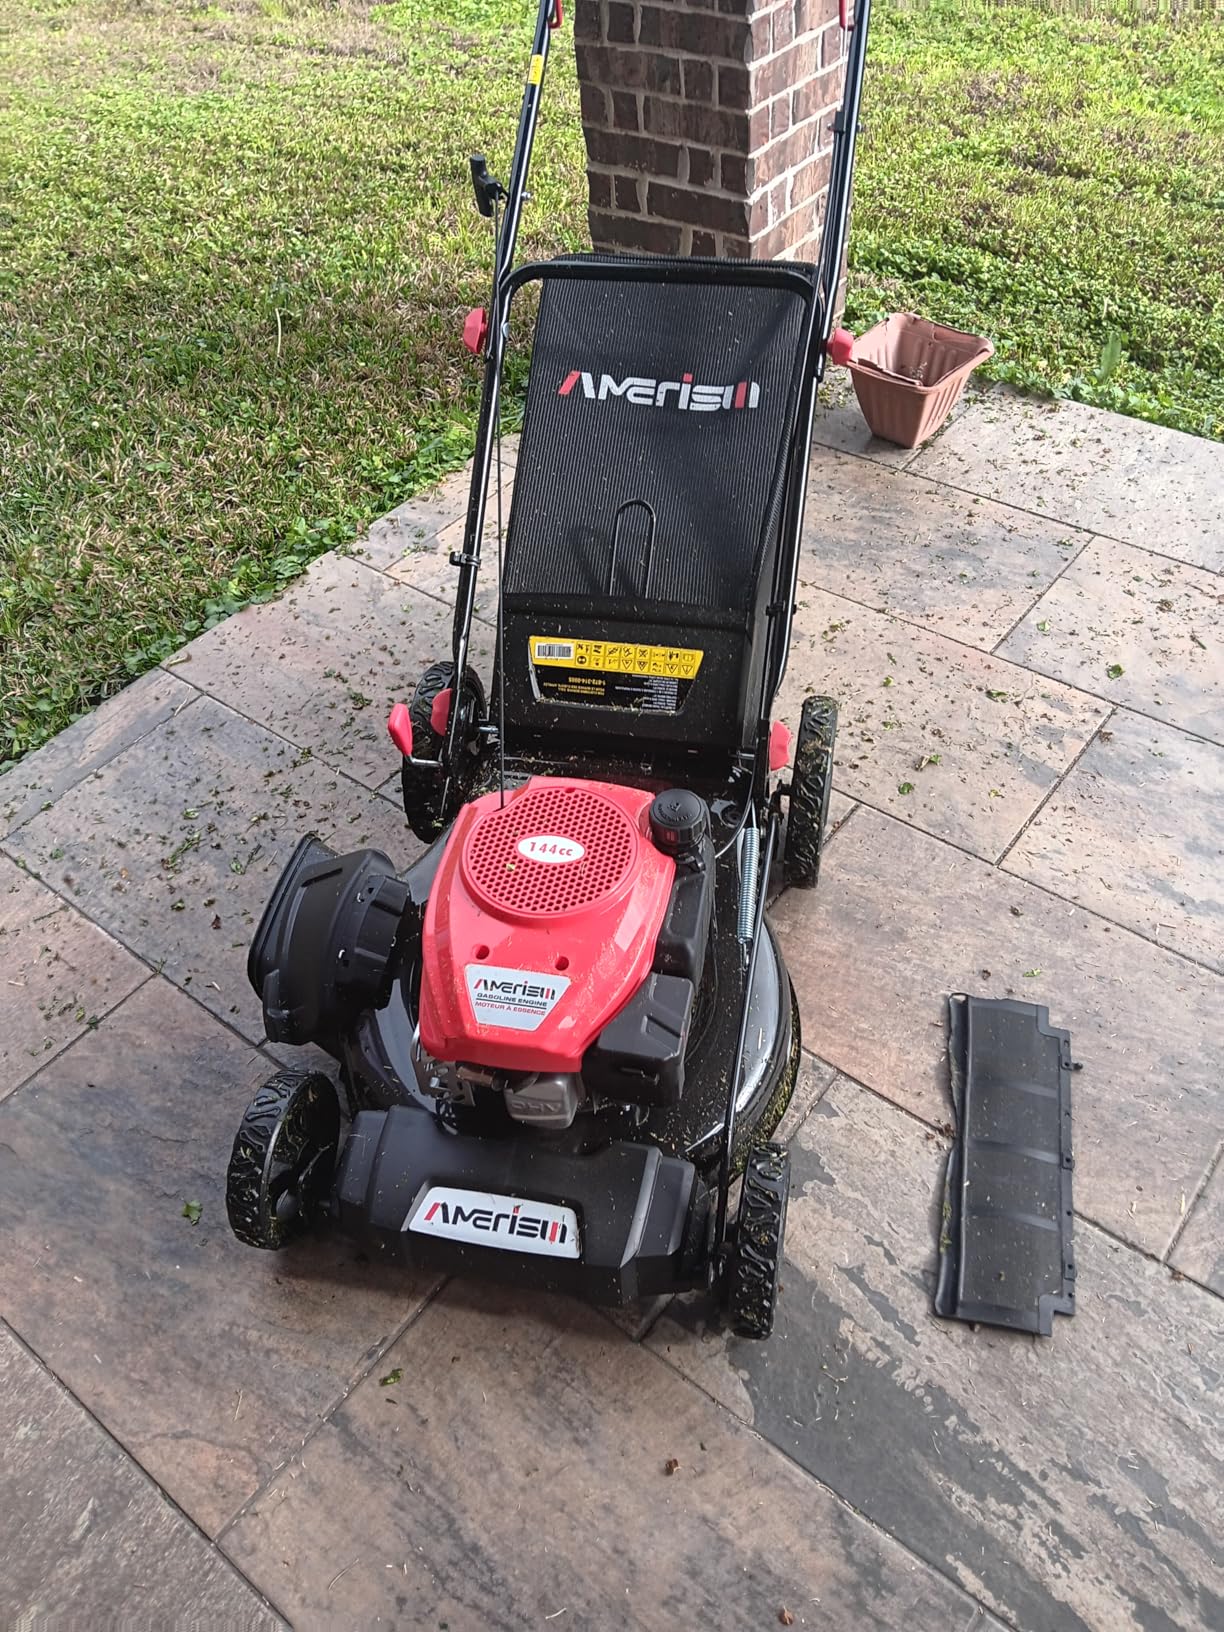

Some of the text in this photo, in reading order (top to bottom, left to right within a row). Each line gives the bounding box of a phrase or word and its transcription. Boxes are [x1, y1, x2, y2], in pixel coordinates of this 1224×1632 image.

[530, 842, 573, 856] 144cc
[477, 992, 548, 1007] GASOLINE ENGINE
[475, 1001, 505, 1010] MOTEUR
[513, 1006, 546, 1016] ESSENCE
